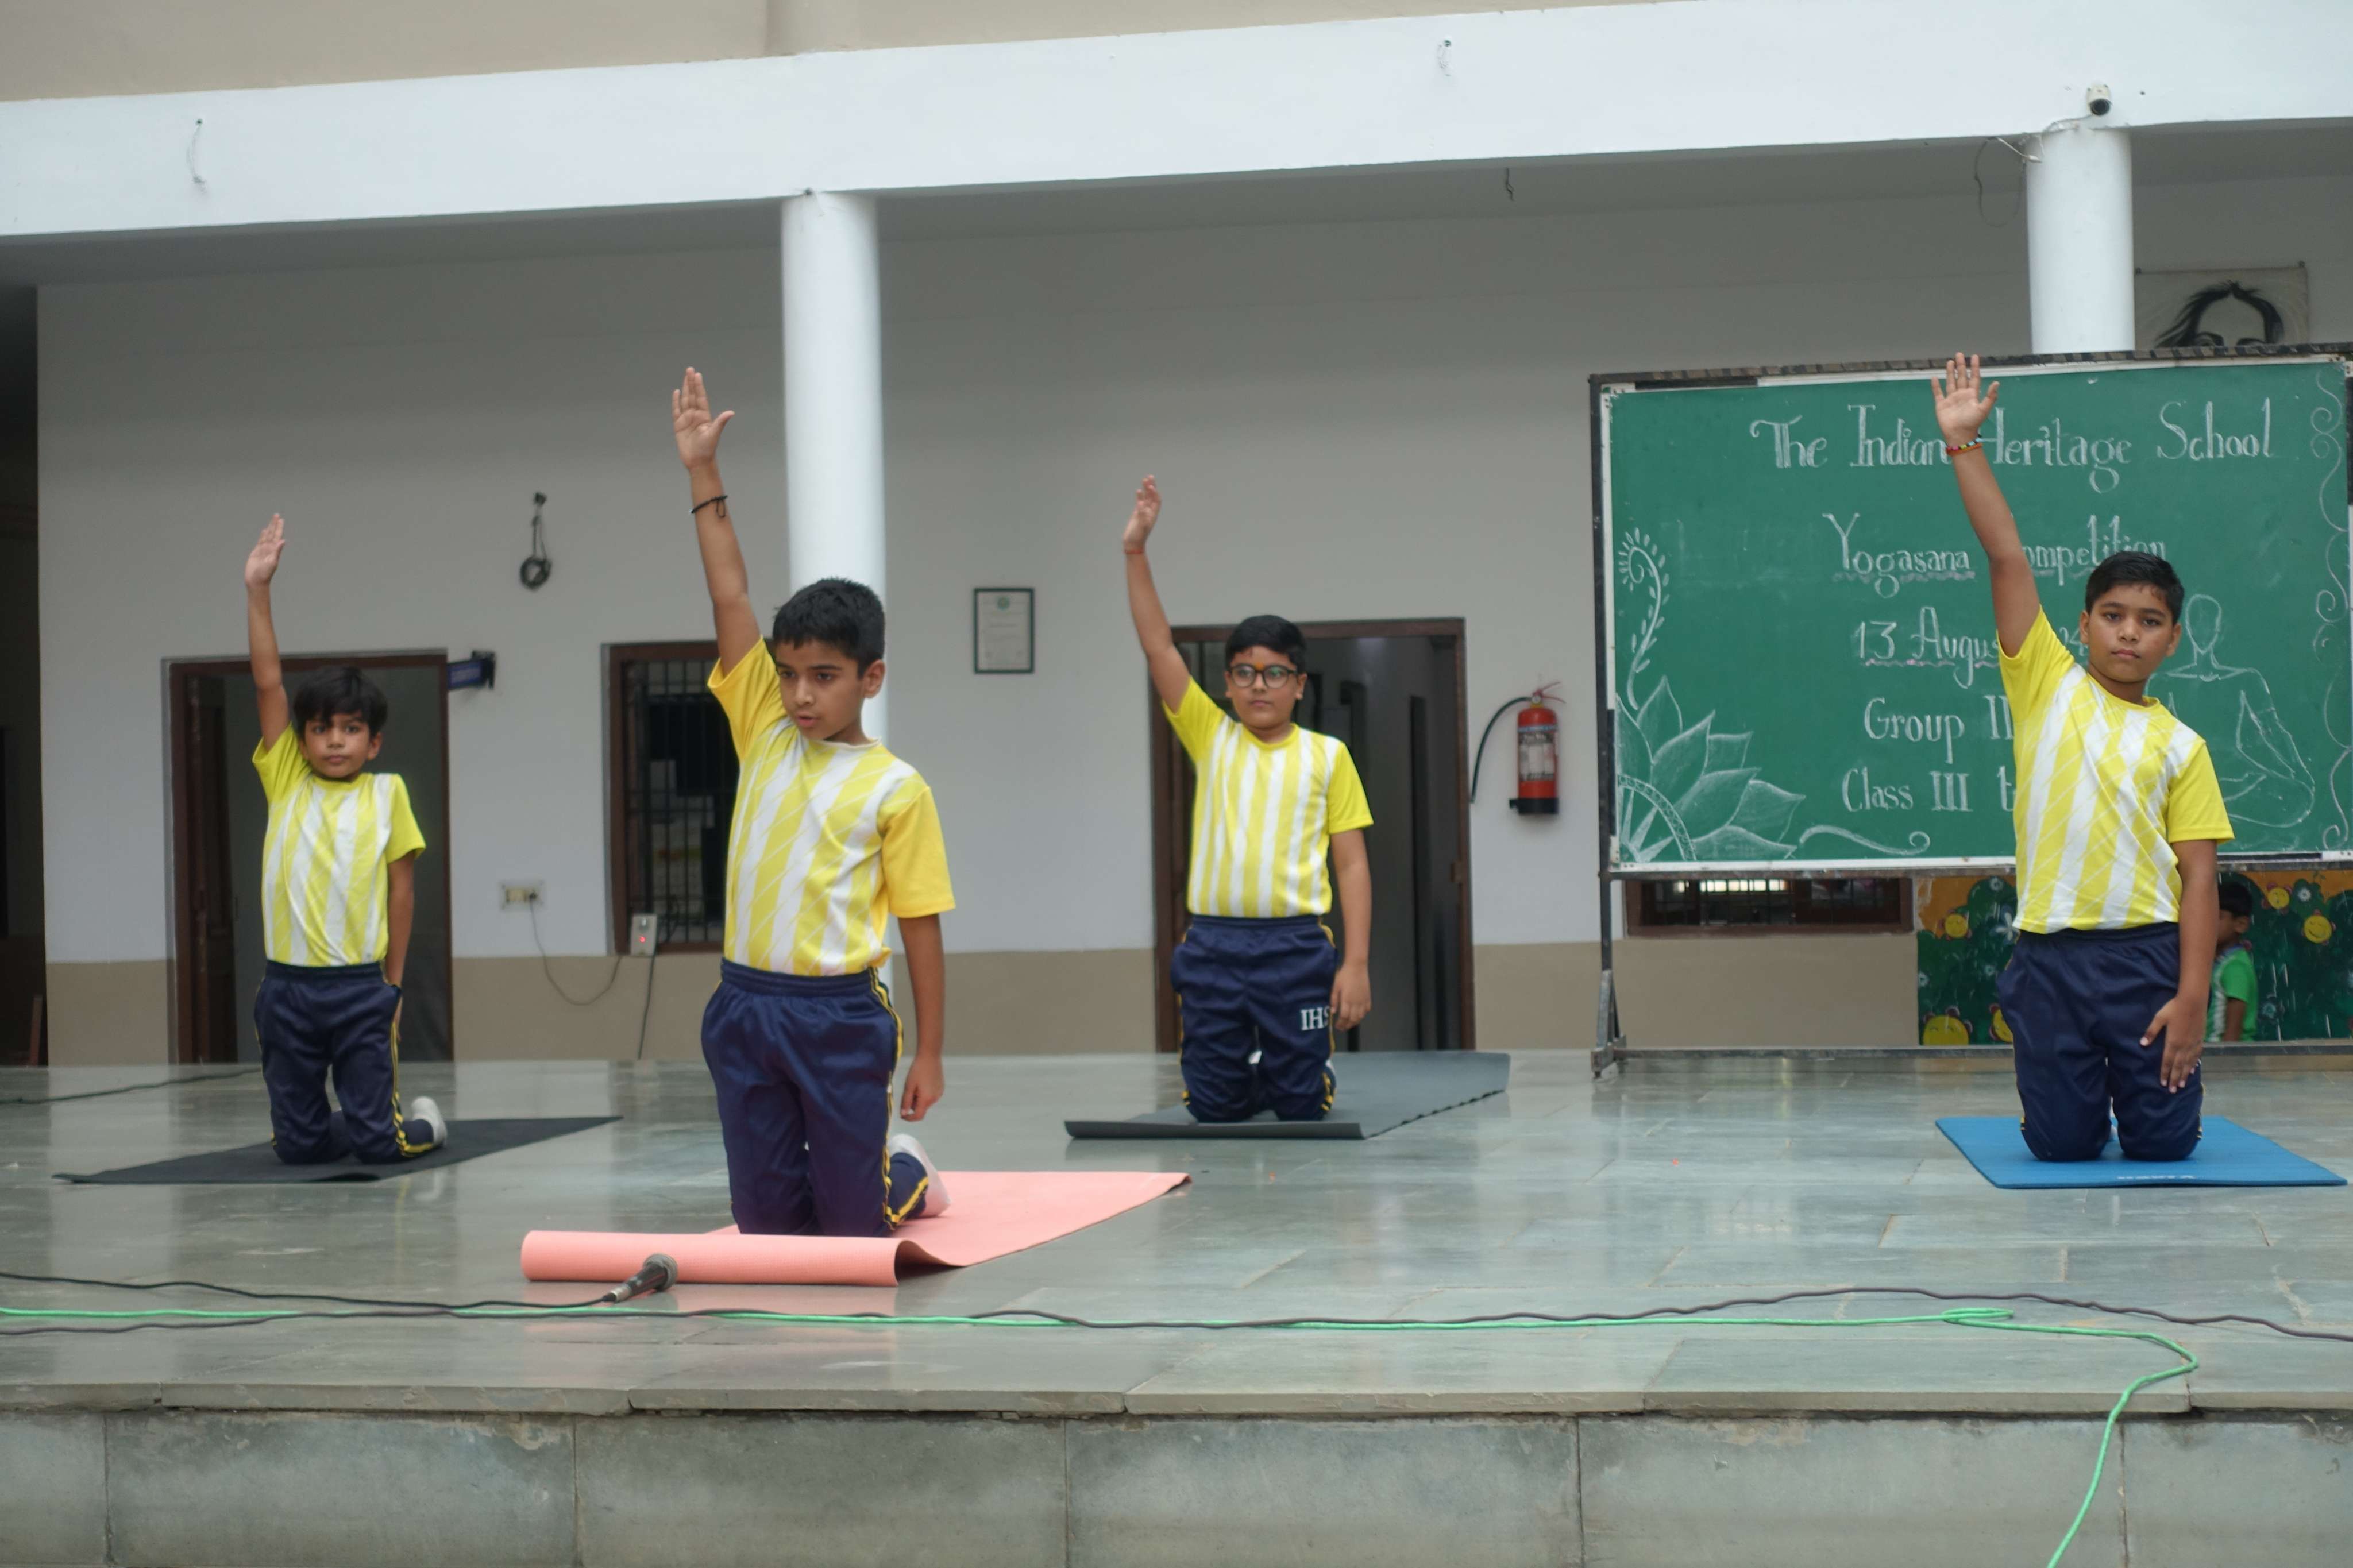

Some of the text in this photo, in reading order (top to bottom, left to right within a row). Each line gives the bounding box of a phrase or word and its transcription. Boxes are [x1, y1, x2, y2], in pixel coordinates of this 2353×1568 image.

[1750, 415, 1828, 468] The
[1848, 405, 1952, 466] Indian
[2157, 397, 2275, 459] School
[1822, 513, 2167, 598] Yogasana ompetition
[1853, 606, 2089, 689] 13 Augus 24
[1864, 697, 1965, 764] Group
[1842, 766, 2016, 812] Class III t
